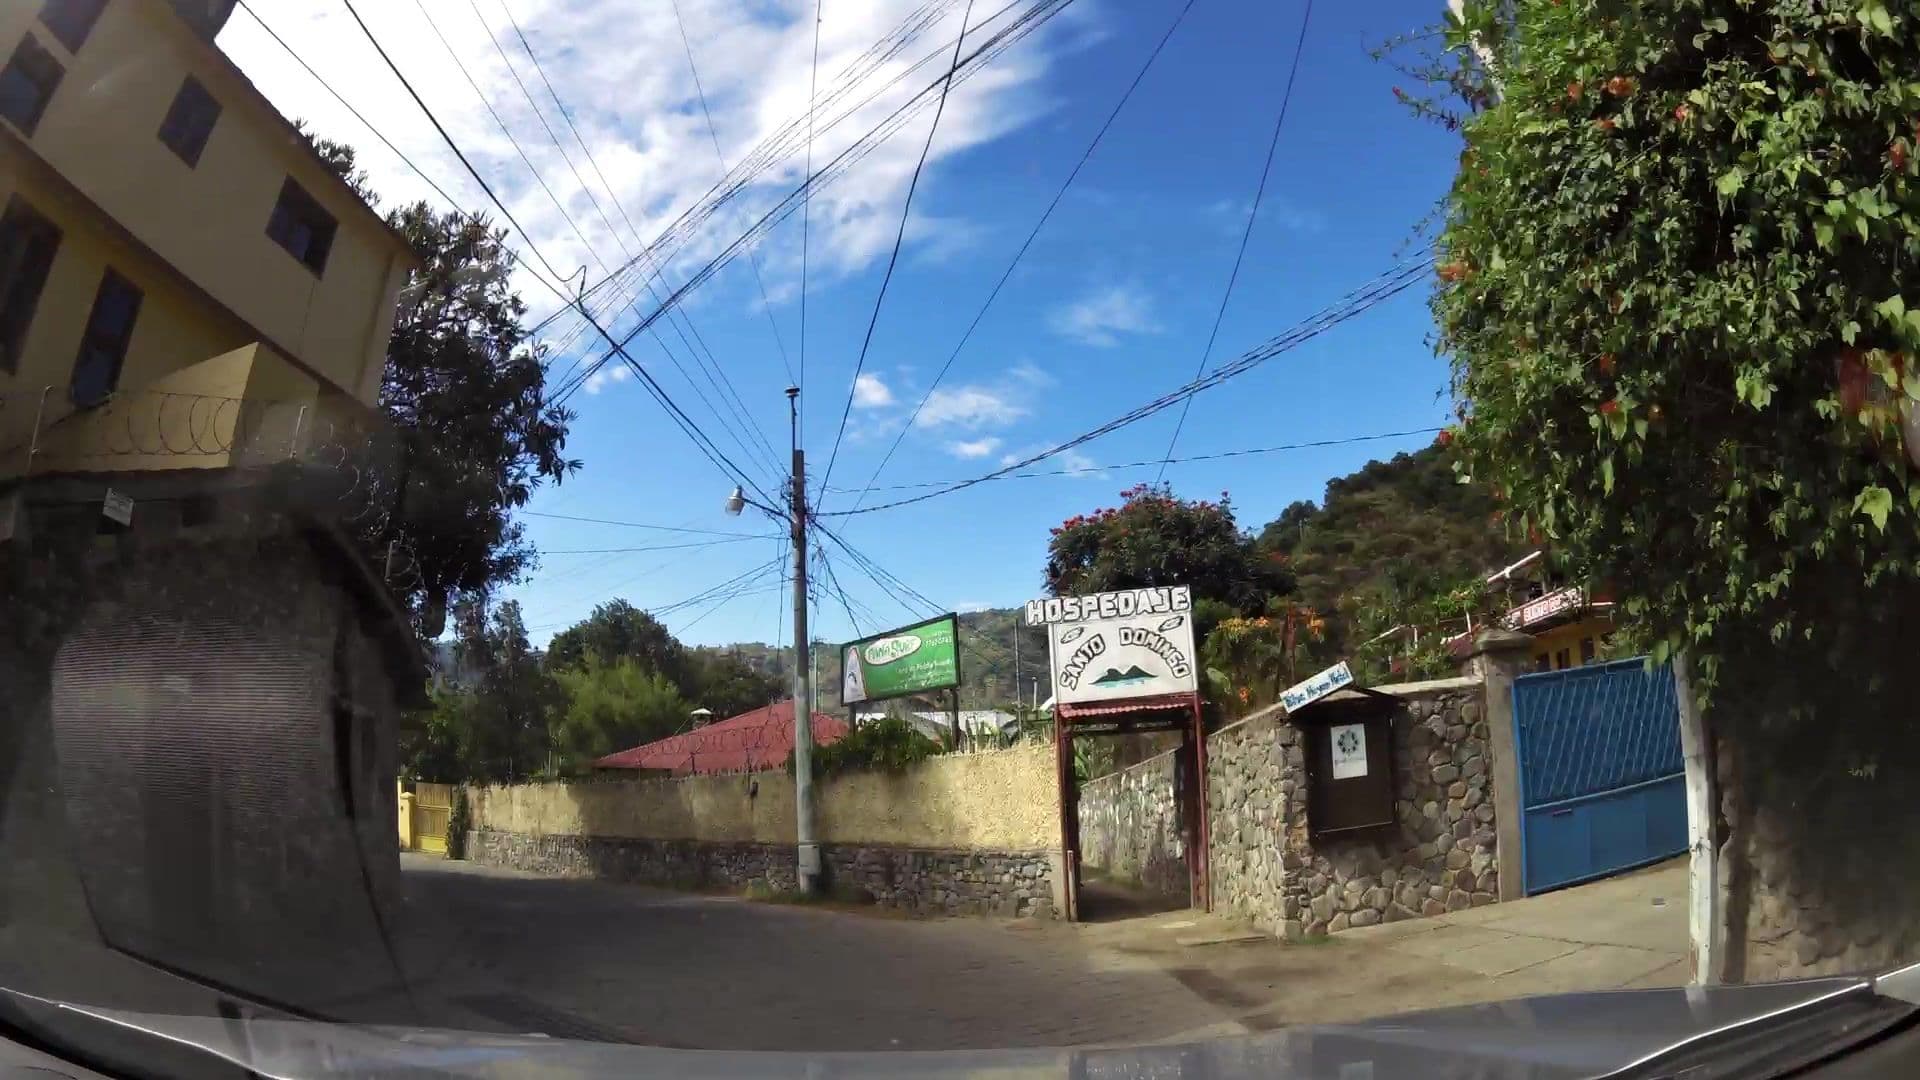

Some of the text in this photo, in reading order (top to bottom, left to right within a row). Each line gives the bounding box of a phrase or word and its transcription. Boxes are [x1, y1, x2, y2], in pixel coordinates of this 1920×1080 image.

[1027, 586, 1190, 625] HOSPEDAJE
[1060, 626, 1191, 691] SANTO DOMINGO
